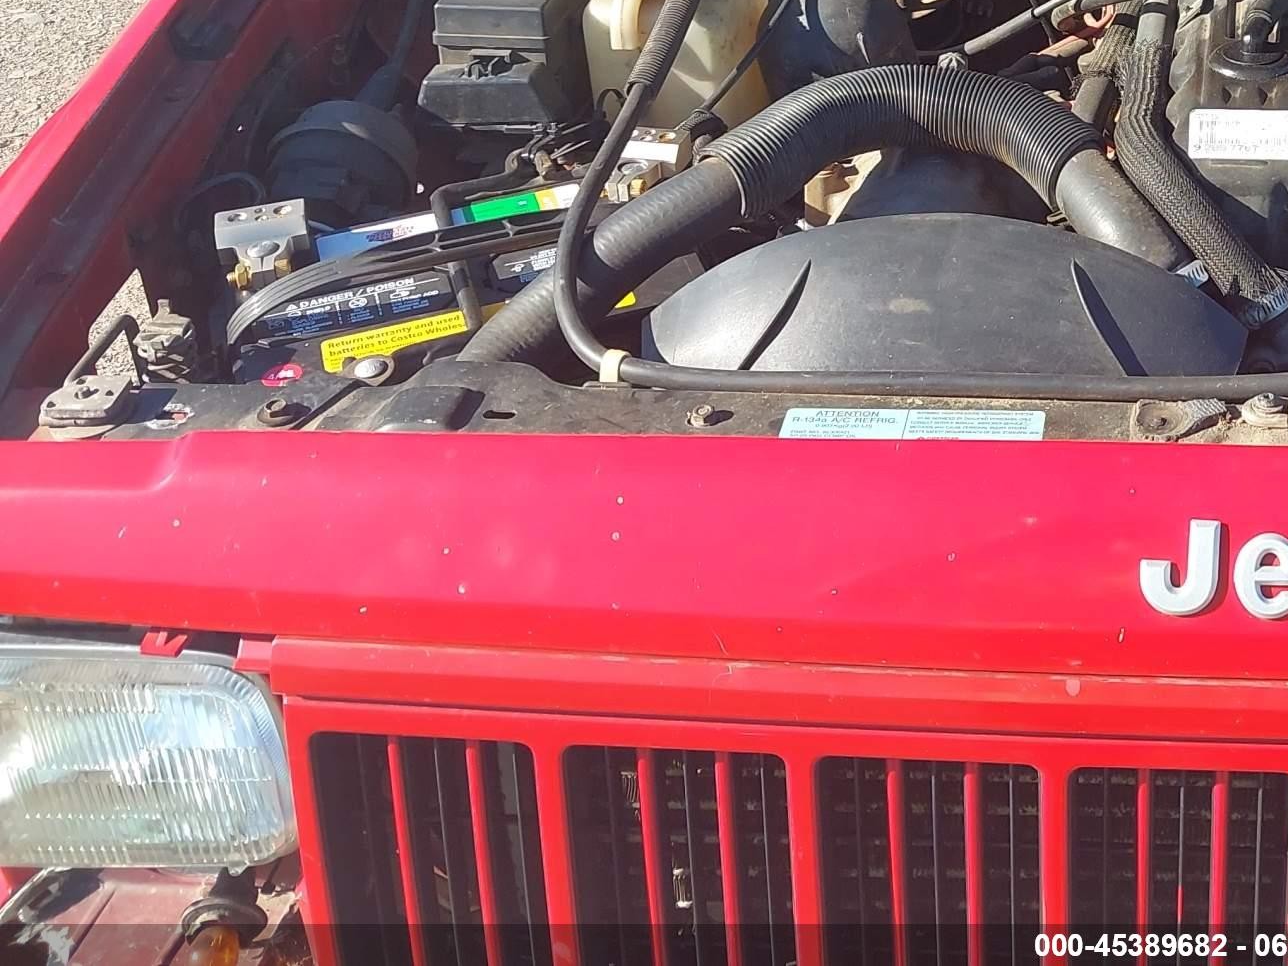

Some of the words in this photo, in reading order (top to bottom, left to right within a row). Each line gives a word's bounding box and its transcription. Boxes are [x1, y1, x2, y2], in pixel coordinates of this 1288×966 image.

[300, 291, 353, 311] DANGER
[366, 277, 415, 294] POISON
[327, 335, 364, 349] Return
[366, 326, 411, 342] warranty
[414, 320, 434, 332] and
[436, 315, 460, 327] used
[328, 341, 375, 357] batteries
[378, 338, 389, 347] to
[390, 331, 423, 344] Costco
